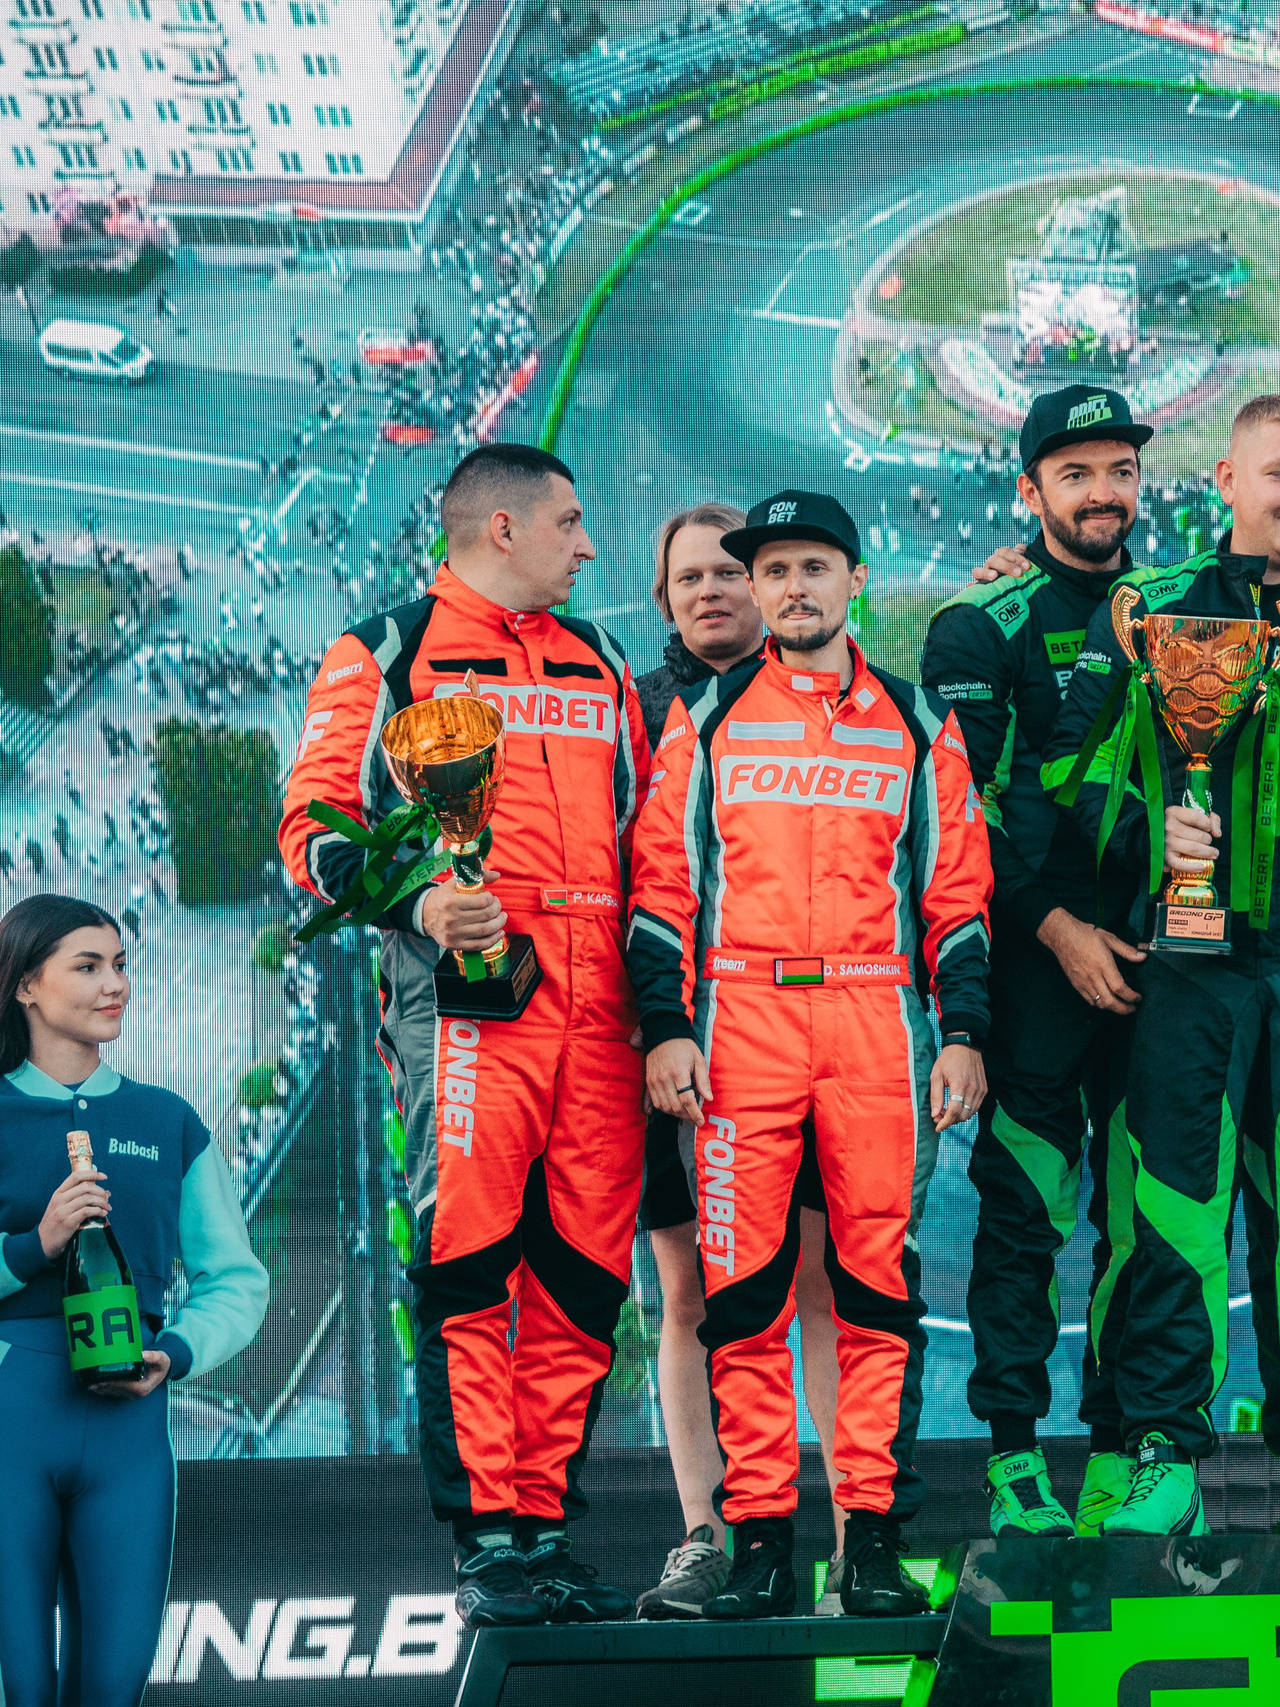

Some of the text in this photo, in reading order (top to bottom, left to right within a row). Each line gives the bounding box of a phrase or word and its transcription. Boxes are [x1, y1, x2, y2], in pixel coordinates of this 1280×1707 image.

[769, 501, 797, 514] FON
[768, 511, 796, 524] BET
[1148, 582, 1179, 598] OMP
[998, 602, 1021, 623] OMP
[326, 661, 363, 685] freem
[938, 682, 987, 694] Blockchain
[727, 762, 898, 802] FONBET
[1260, 760, 1275, 827] BETERA
[1253, 853, 1270, 919] BETERA
[573, 892, 584, 904] P.
[1203, 912, 1224, 921] GP
[713, 955, 746, 972] freem
[824, 963, 901, 976] D. SAMOSHKIN
[443, 1019, 481, 1157] ONBET
[108, 1138, 159, 1161] Bulbash
[703, 1113, 736, 1277] FONBET
[1004, 1461, 1029, 1475] OMP
